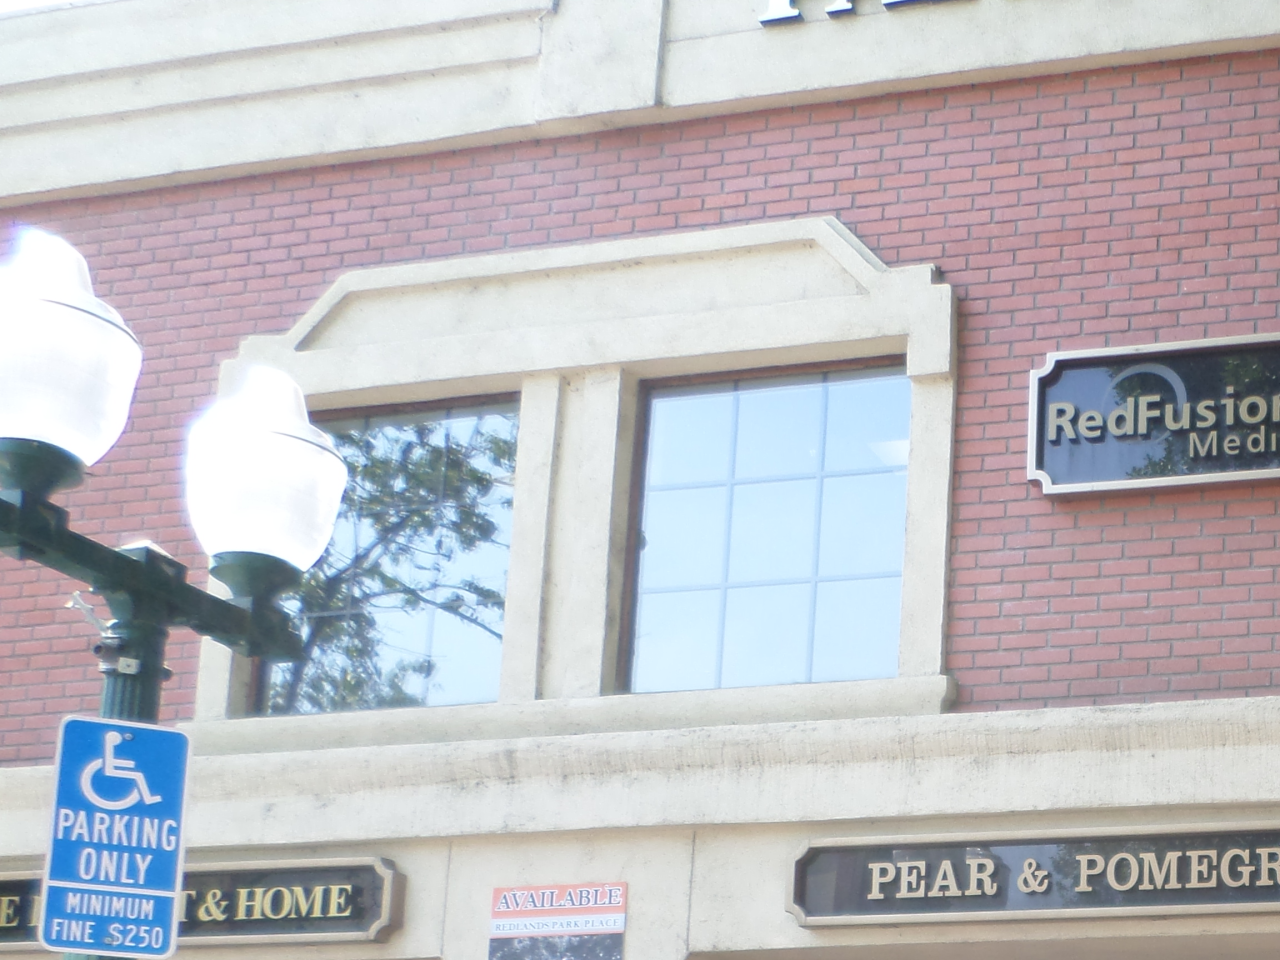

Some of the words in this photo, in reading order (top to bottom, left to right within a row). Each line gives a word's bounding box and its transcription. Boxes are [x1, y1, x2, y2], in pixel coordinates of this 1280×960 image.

[56, 808, 178, 851] PARKING
[78, 847, 154, 885] ONLY
[867, 858, 998, 900] PEAR
[1017, 857, 1049, 893] &
[65, 892, 155, 921] MINIMUM
[198, 888, 228, 922] &
[233, 885, 353, 922] HOME
[495, 886, 622, 911] AVAILABLE
[51, 918, 97, 943] FINE
[107, 922, 164, 949] $250
[495, 920, 550, 932] REDLANDS
[551, 920, 581, 930] PARK
[584, 918, 620, 928] PLACE
